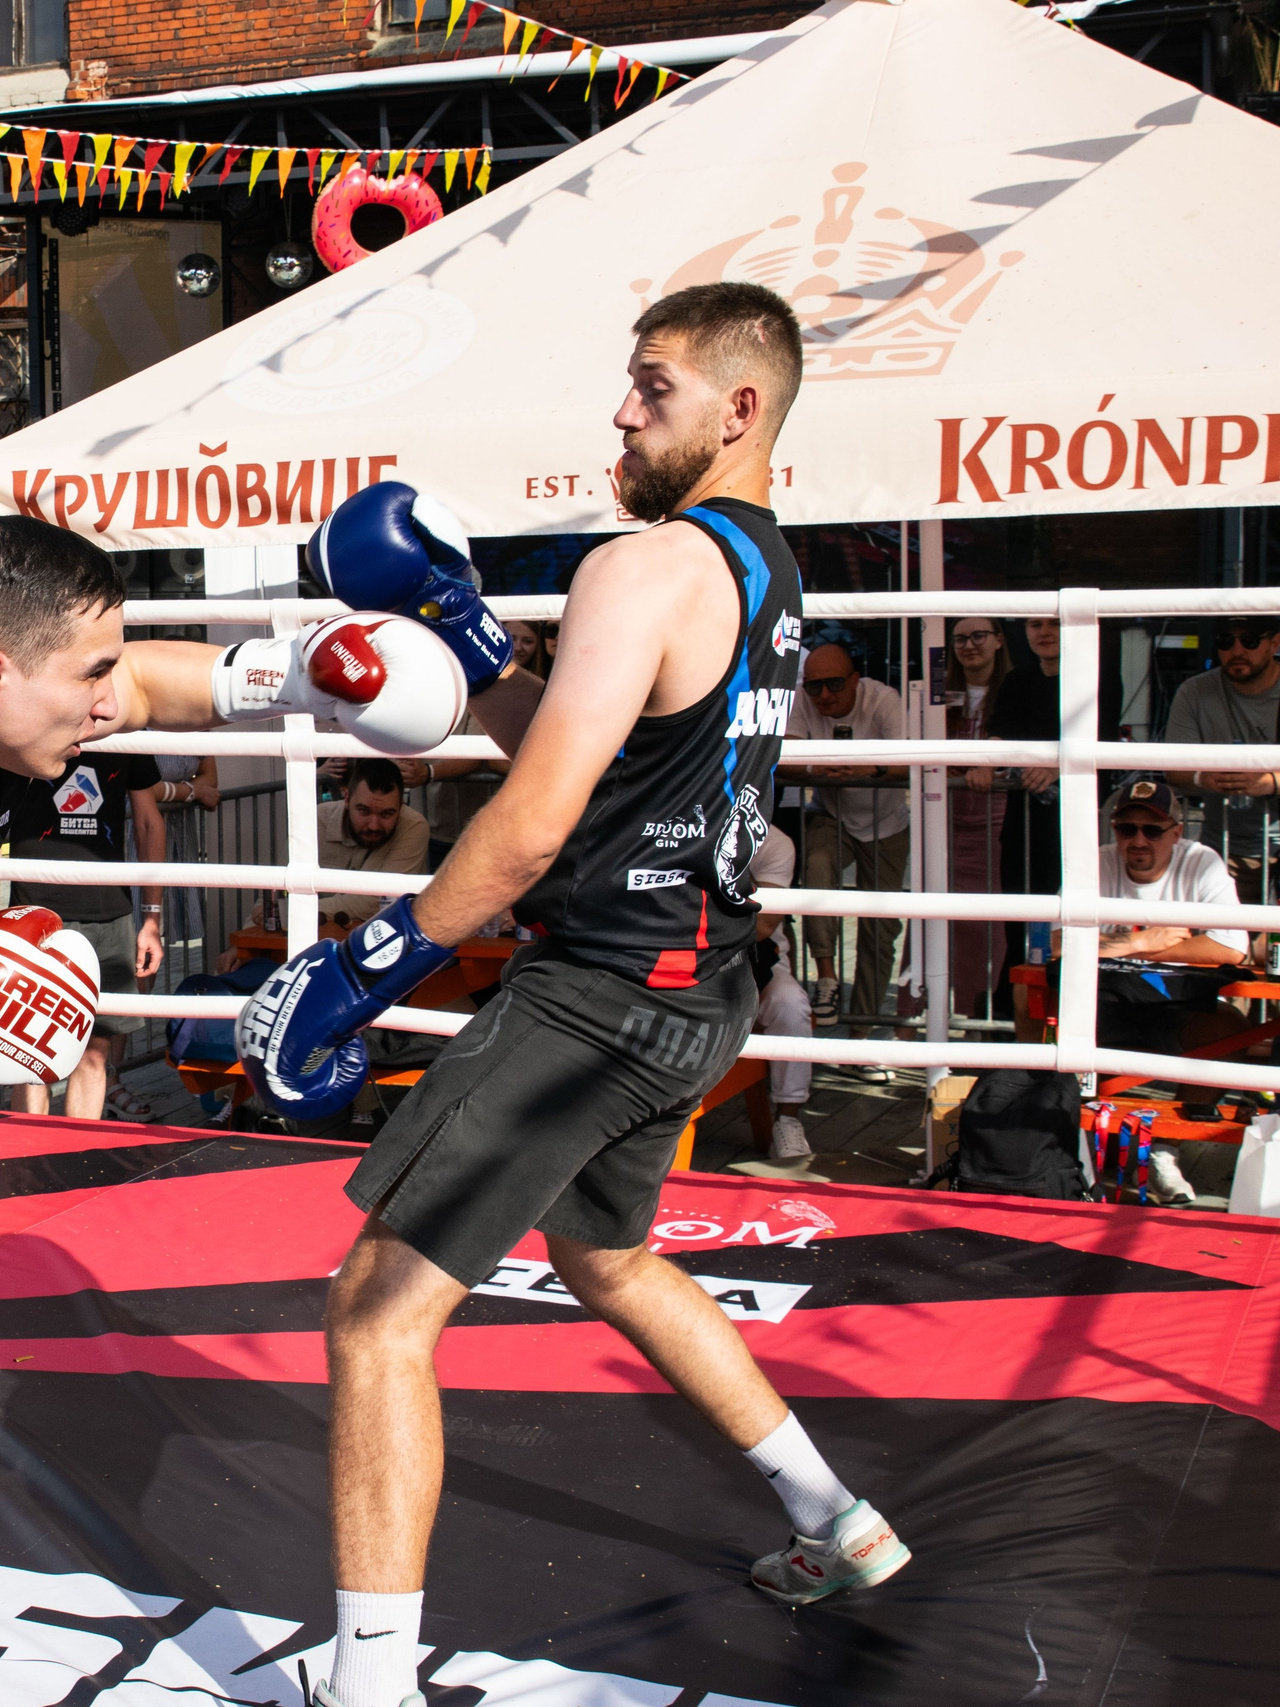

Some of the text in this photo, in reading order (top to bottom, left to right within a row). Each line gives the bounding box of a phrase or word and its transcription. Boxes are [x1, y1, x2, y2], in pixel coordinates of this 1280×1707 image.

[245, 290, 464, 356] БЕЗАЛКОЛЬНАЯ
[525, 474, 594, 499] EST.
[247, 676, 279, 688] HILL
[60, 817, 98, 829] БИТВА
[655, 839, 679, 848] GIN
[14, 1050, 35, 1067] BEST
